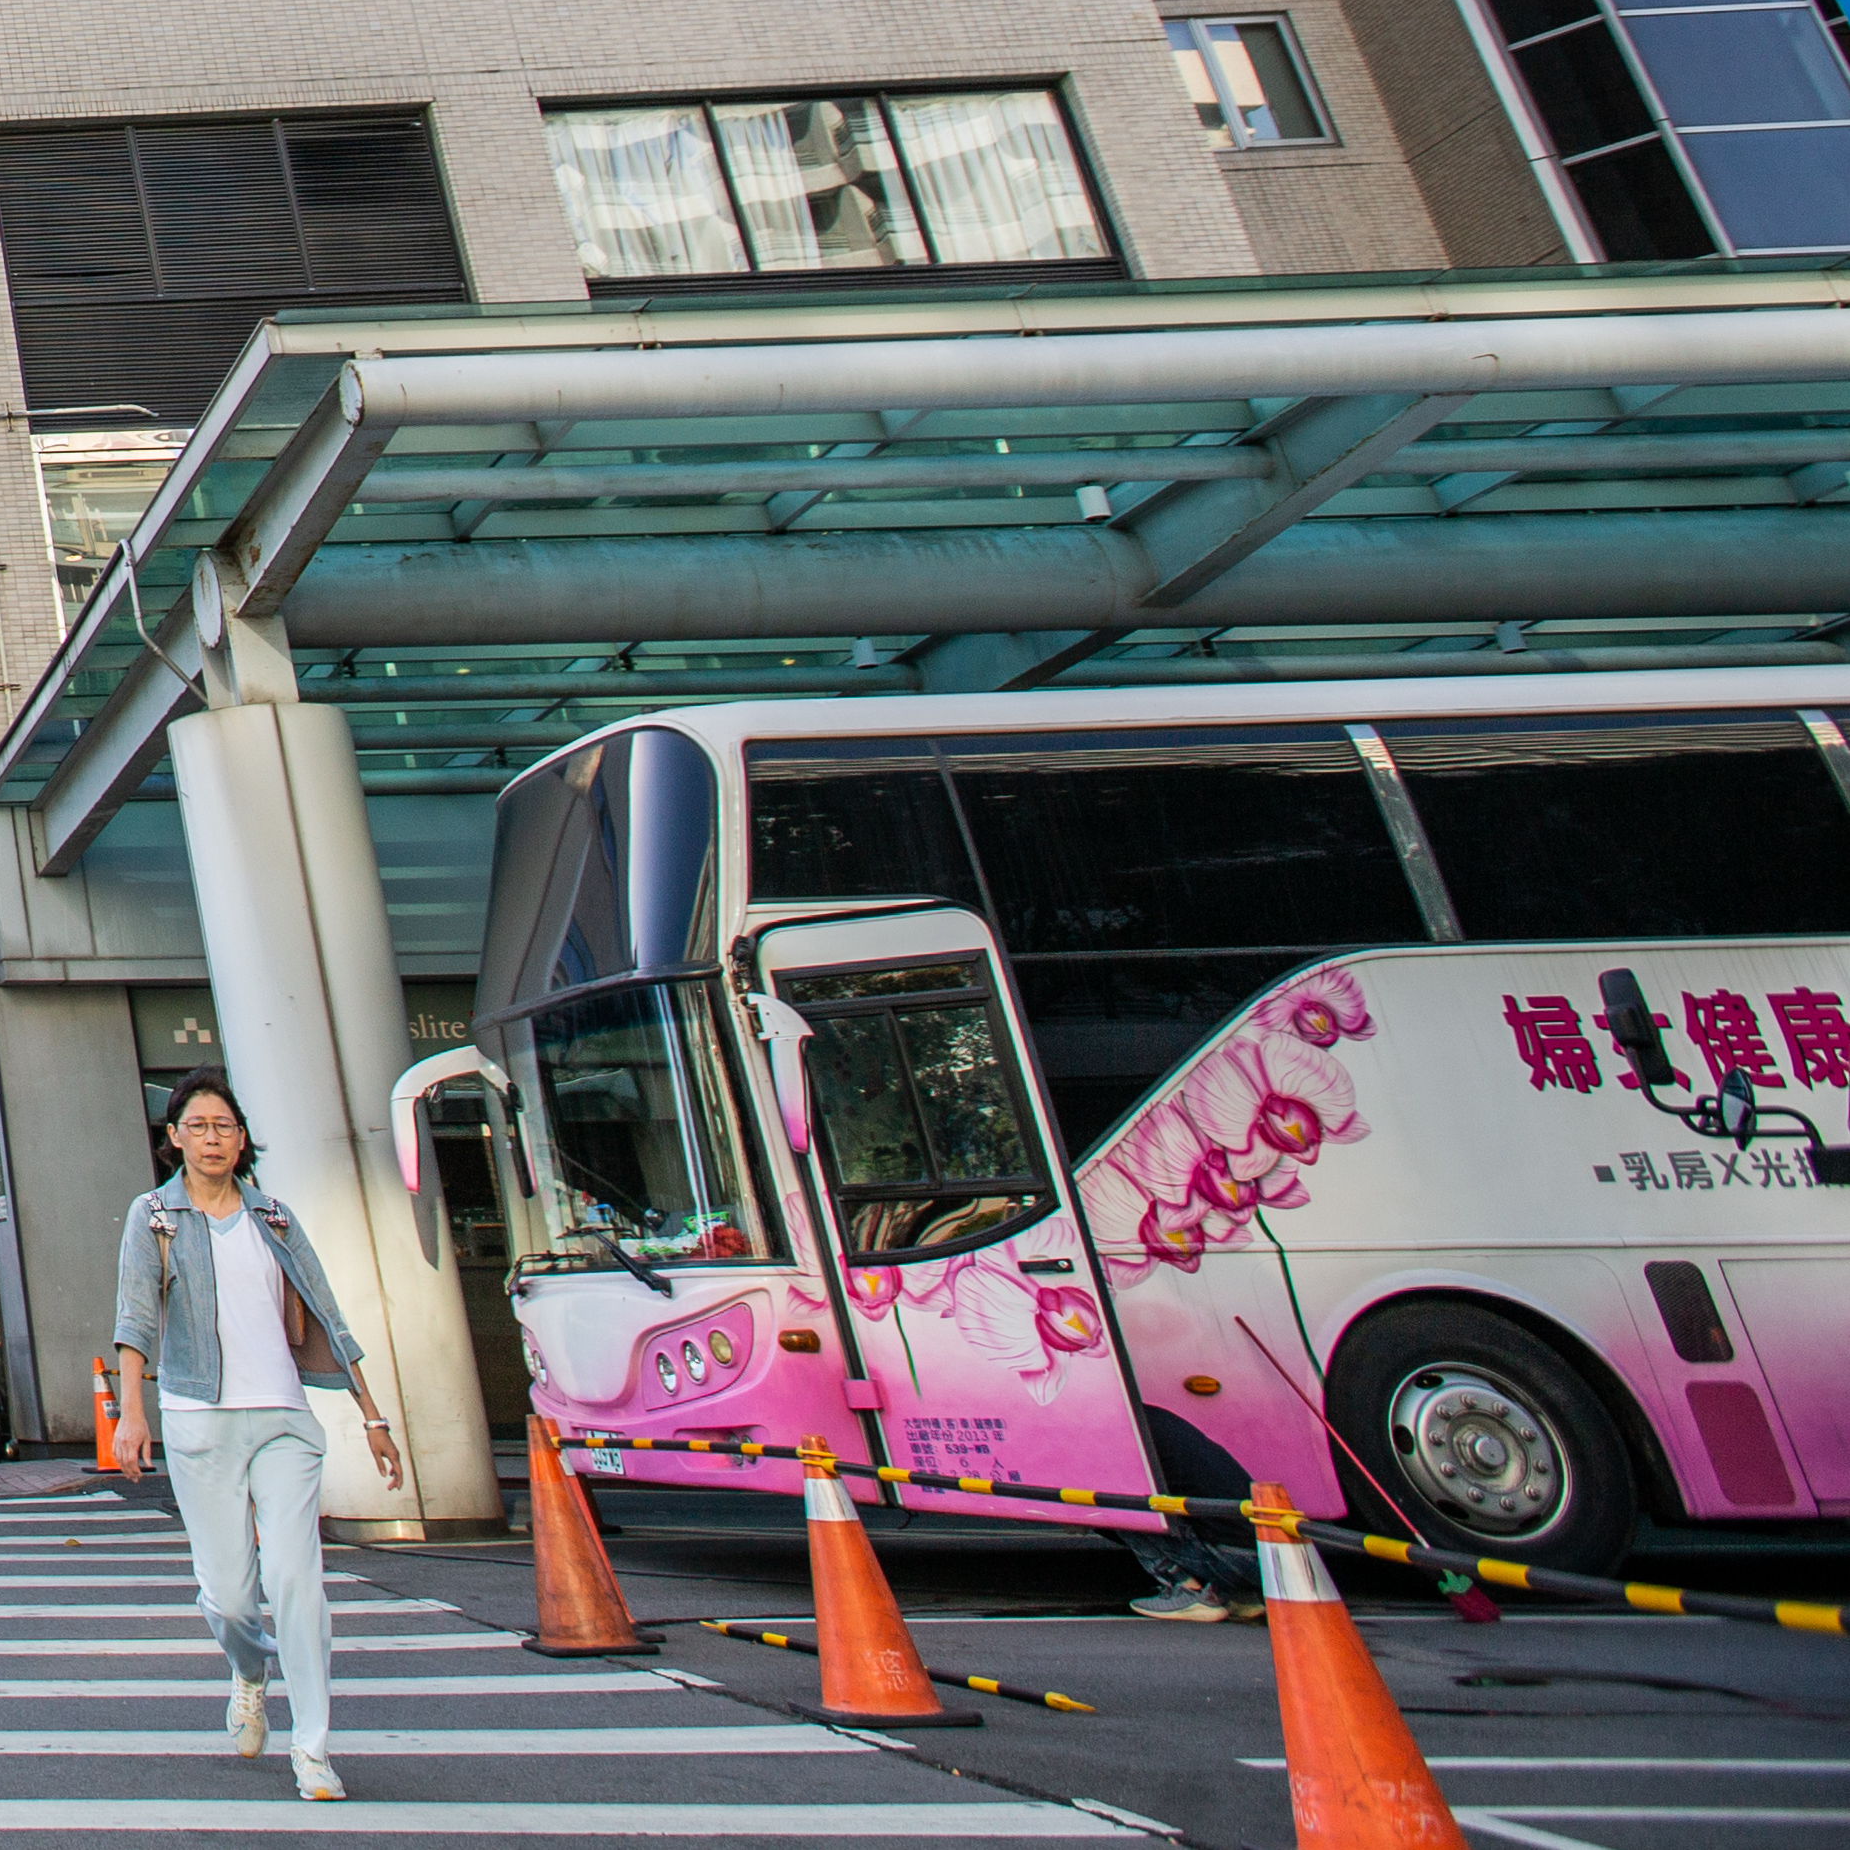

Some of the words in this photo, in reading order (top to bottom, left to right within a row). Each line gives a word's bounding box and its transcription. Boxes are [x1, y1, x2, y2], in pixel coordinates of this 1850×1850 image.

[408, 1014, 467, 1040] slite
[956, 1430, 990, 1442] 2013
[959, 1457, 970, 1468] 6
